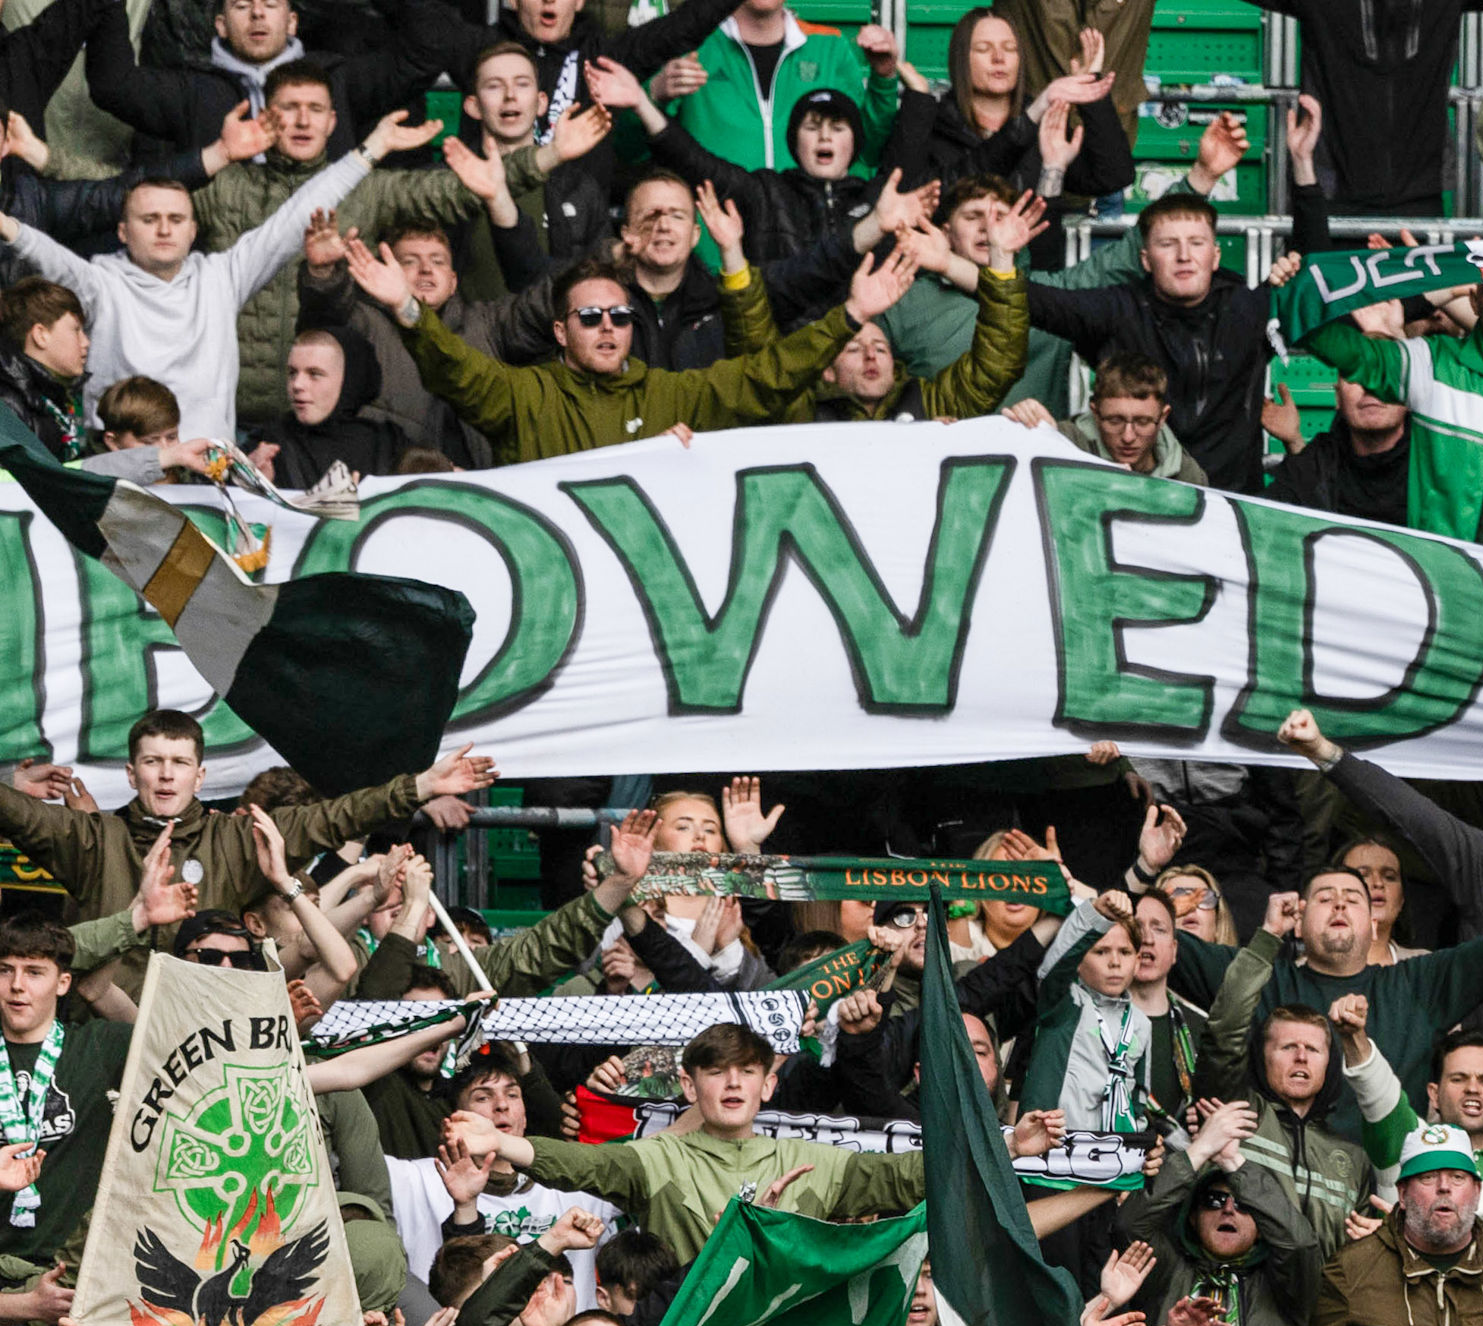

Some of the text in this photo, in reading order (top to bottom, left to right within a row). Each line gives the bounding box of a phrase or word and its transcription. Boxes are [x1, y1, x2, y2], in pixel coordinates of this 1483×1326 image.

[845, 867, 1048, 895] LISBON LIONS
[821, 952, 860, 974] THE
[131, 1019, 236, 1152] GREEN
